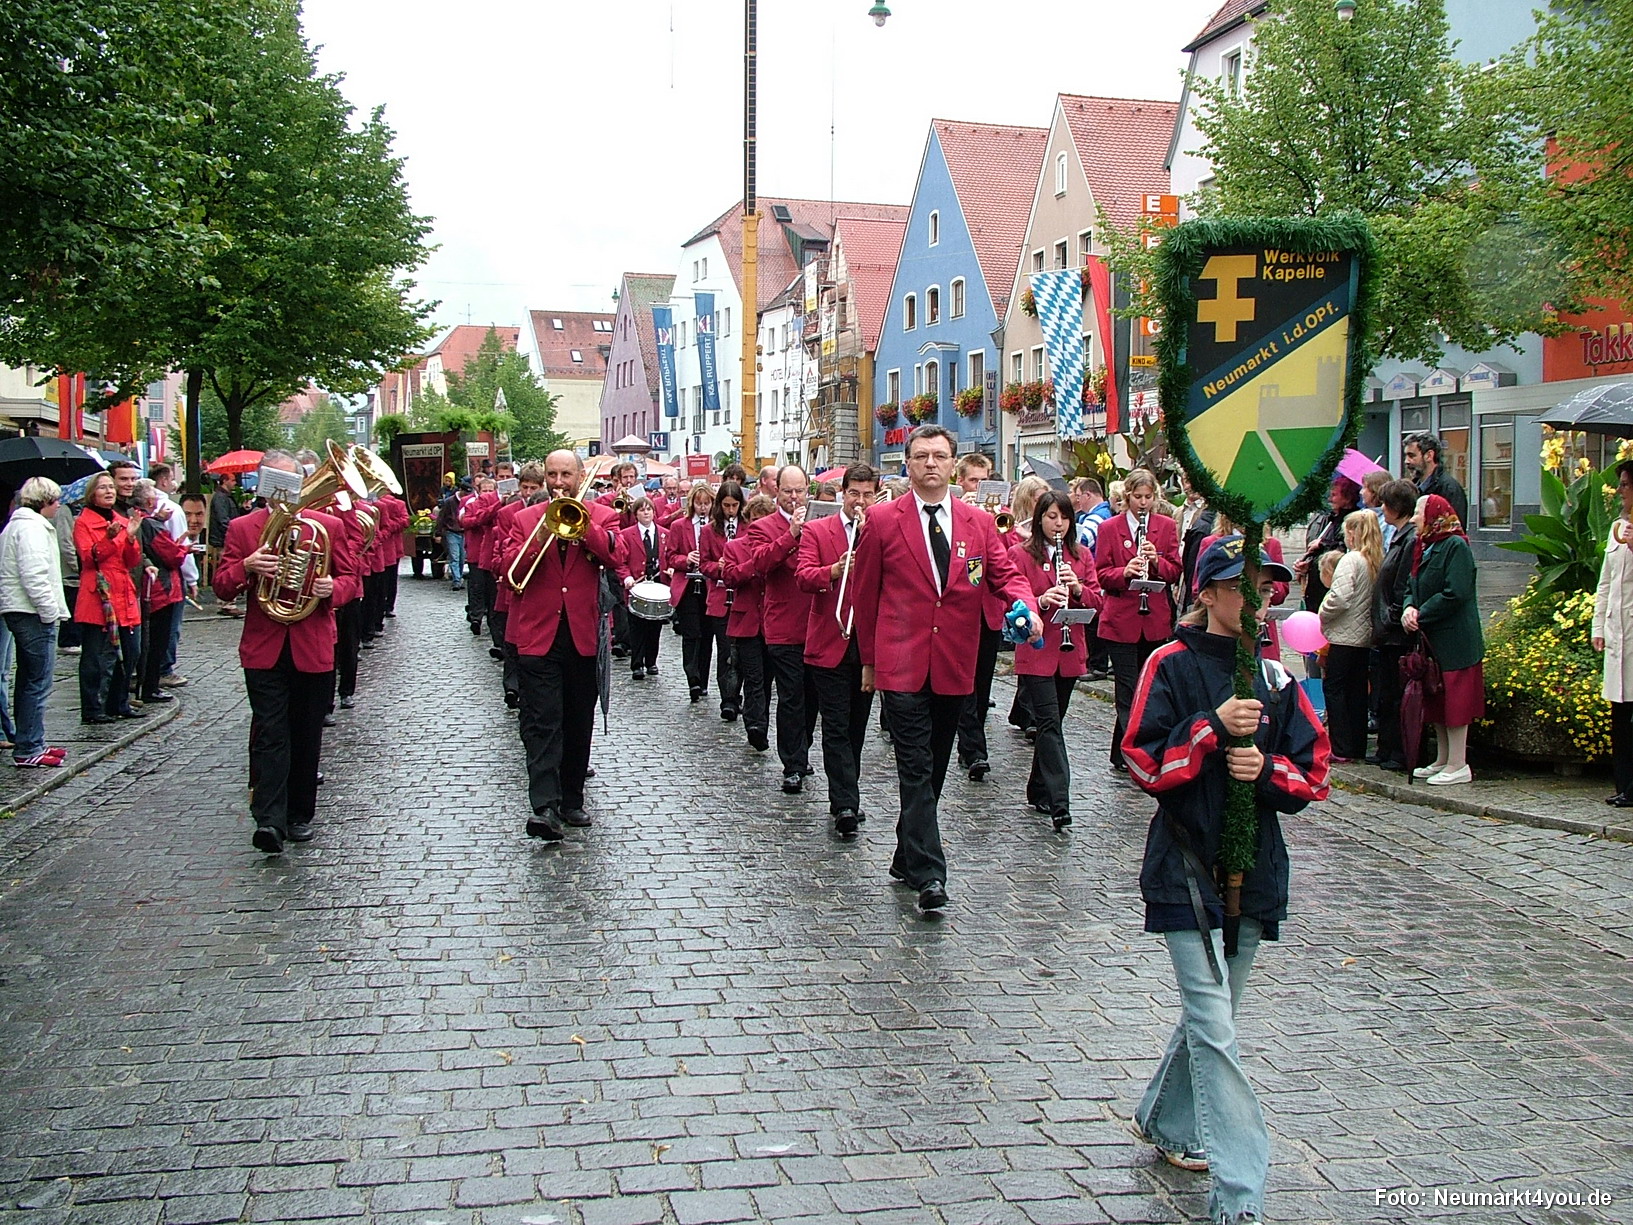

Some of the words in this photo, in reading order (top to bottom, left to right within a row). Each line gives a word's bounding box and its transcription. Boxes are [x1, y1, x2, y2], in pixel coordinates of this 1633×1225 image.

[1263, 249, 1340, 264] Werkvolk
[1262, 264, 1325, 282] Kapelle
[704, 337, 715, 379] RUPPERT
[1132, 357, 1146, 365] KIND
[1203, 340, 1279, 399] Neumarkt
